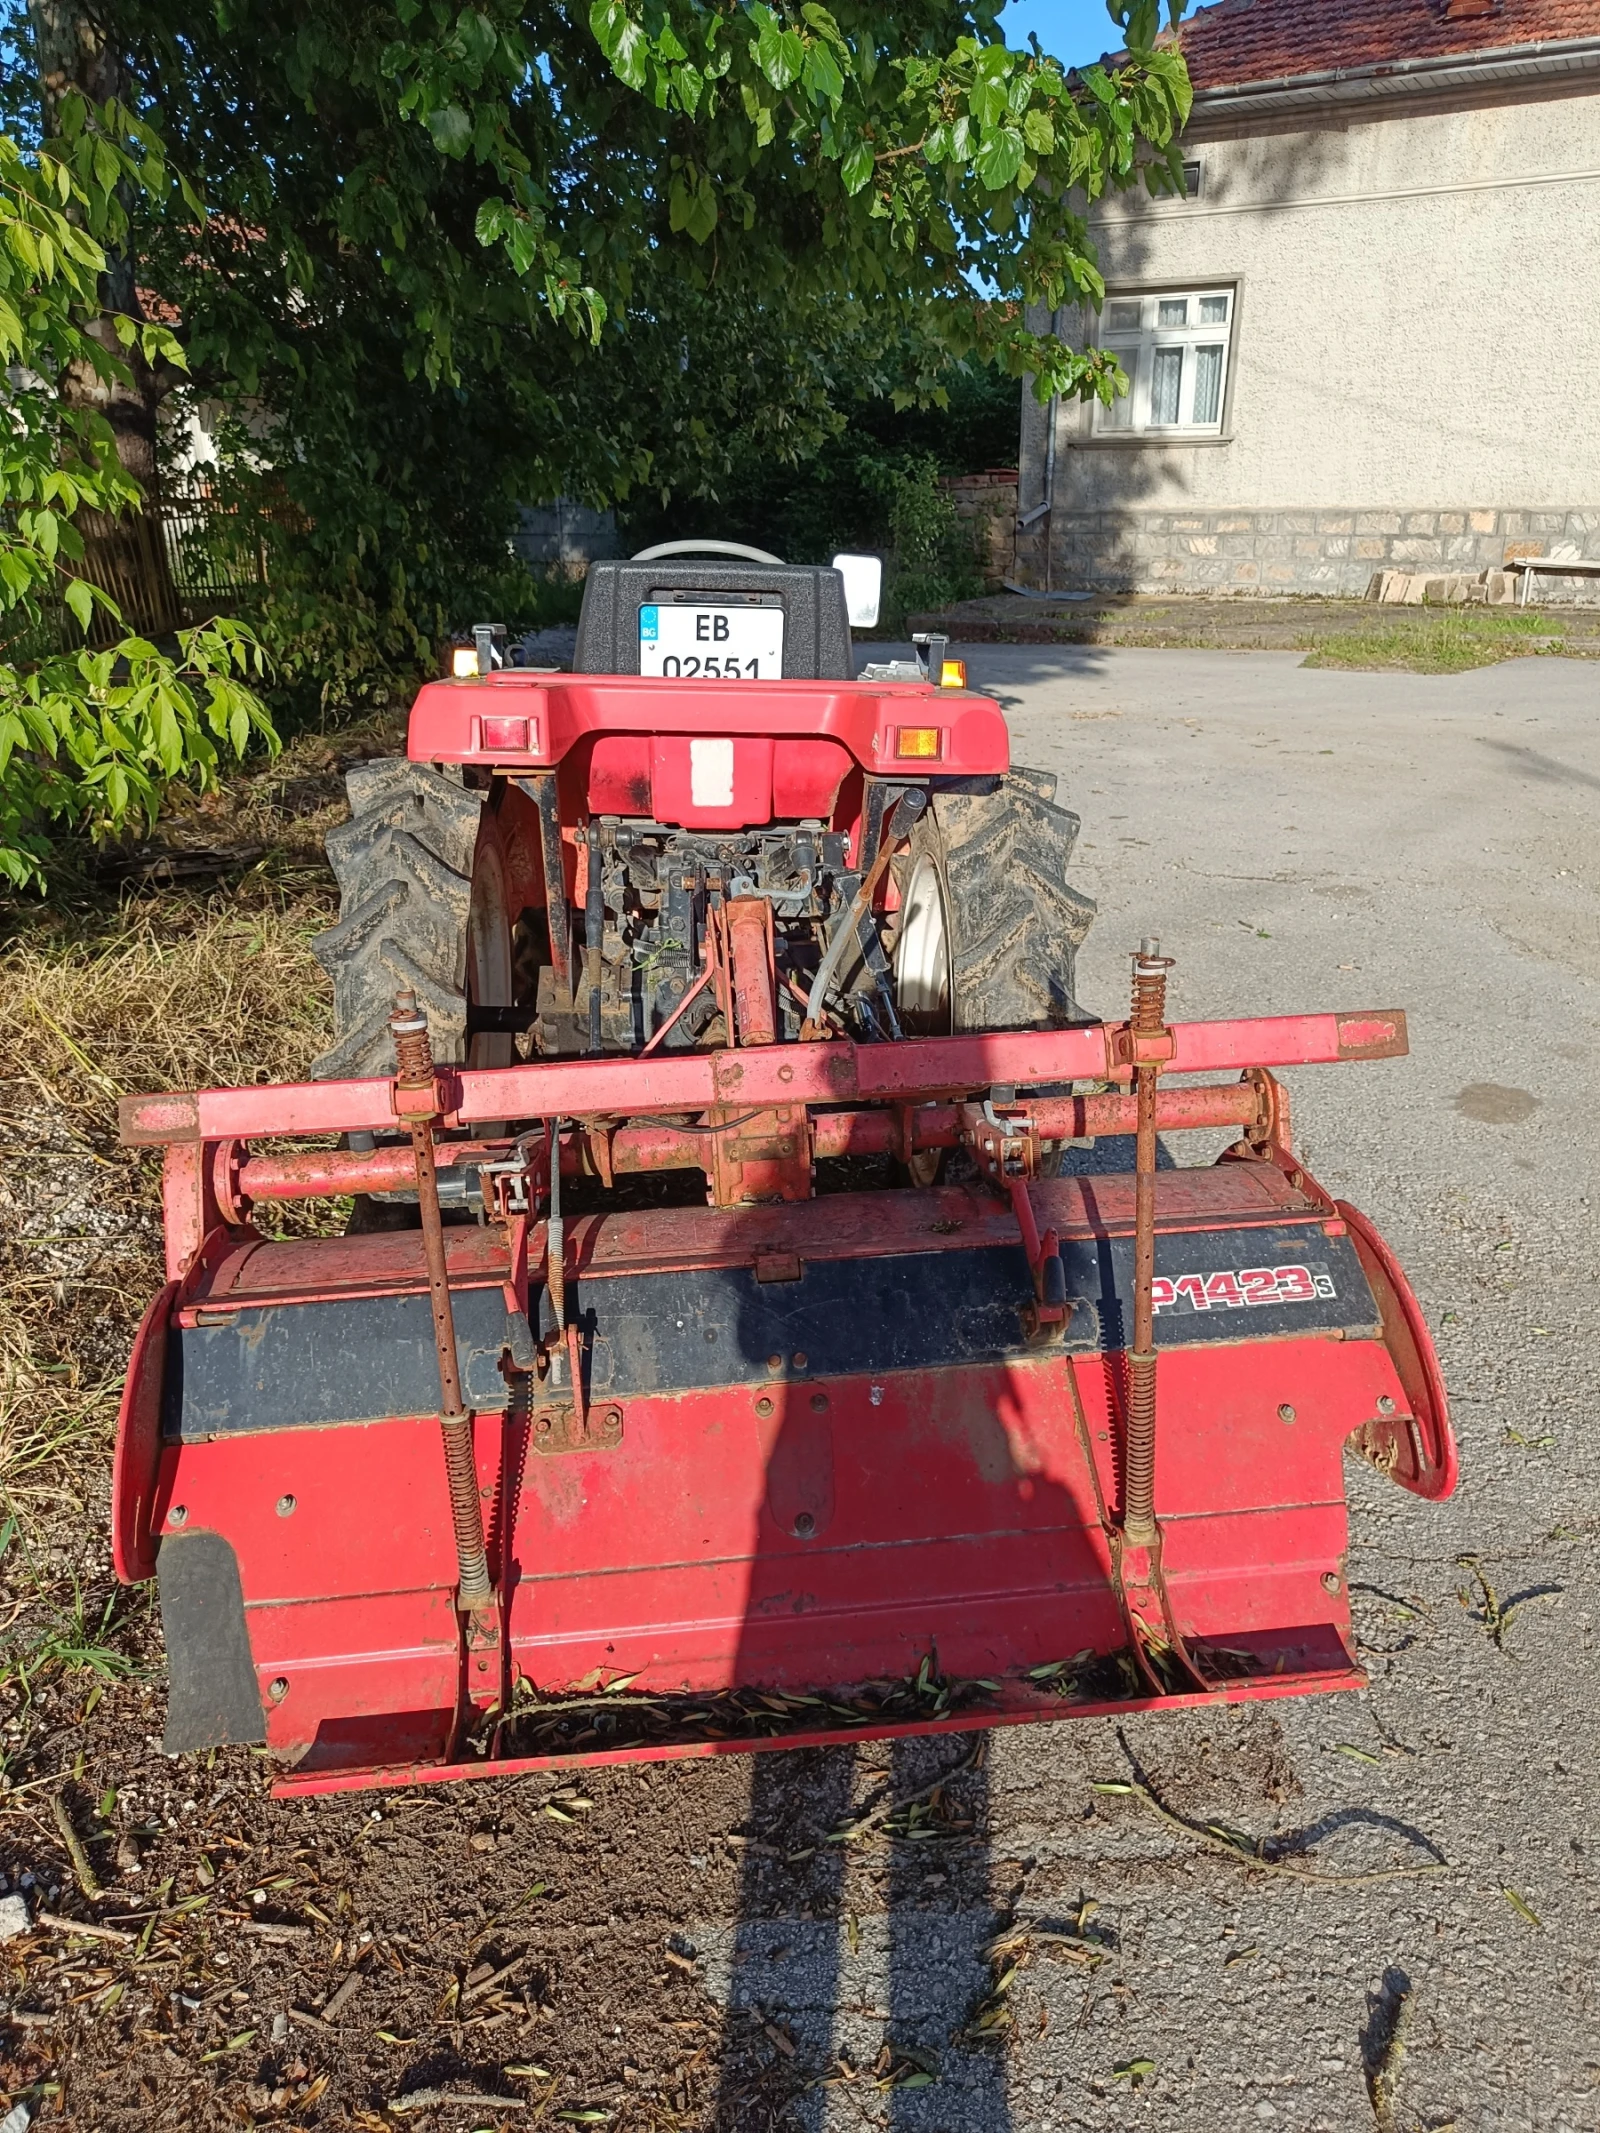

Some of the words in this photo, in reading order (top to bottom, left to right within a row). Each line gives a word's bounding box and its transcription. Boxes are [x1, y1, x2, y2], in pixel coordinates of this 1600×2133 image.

[642, 627, 657, 638] BG
[696, 614, 730, 642] EB
[662, 655, 760, 680] 02551
